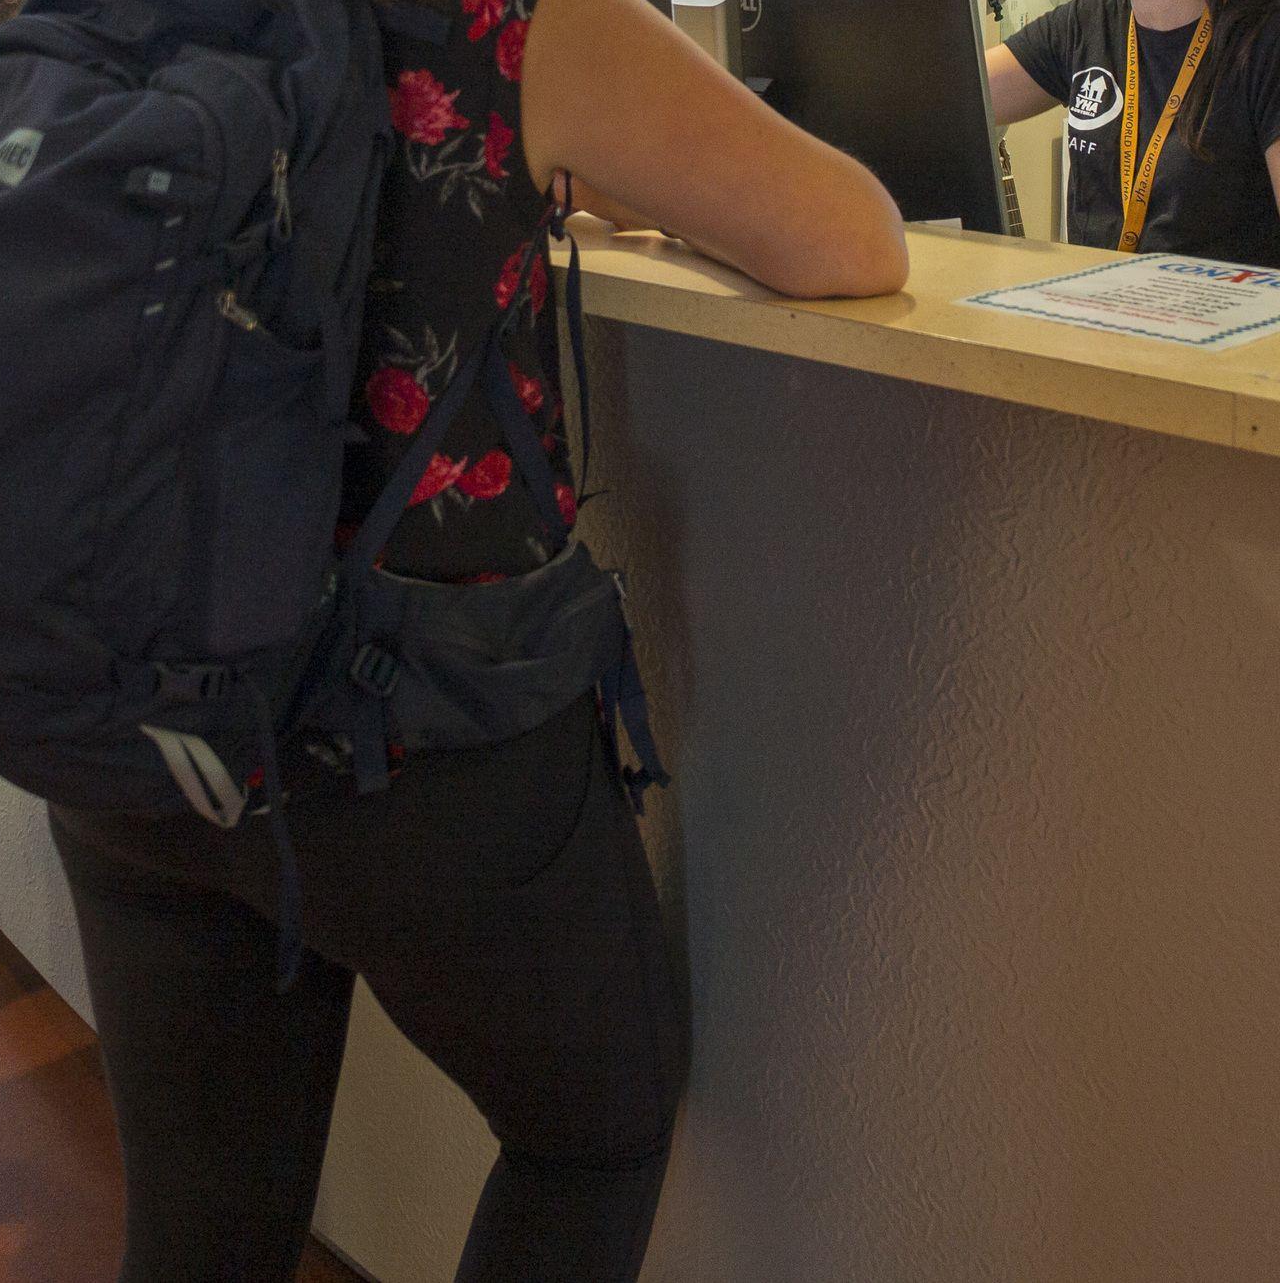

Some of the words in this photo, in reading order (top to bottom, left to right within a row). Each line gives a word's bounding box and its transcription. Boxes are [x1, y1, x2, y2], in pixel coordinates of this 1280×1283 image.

[1128, 69, 1136, 91] AND
[1075, 95, 1099, 114] YHA
[1068, 135, 1097, 155] AFF
[1135, 134, 1162, 205] yha.com.au
